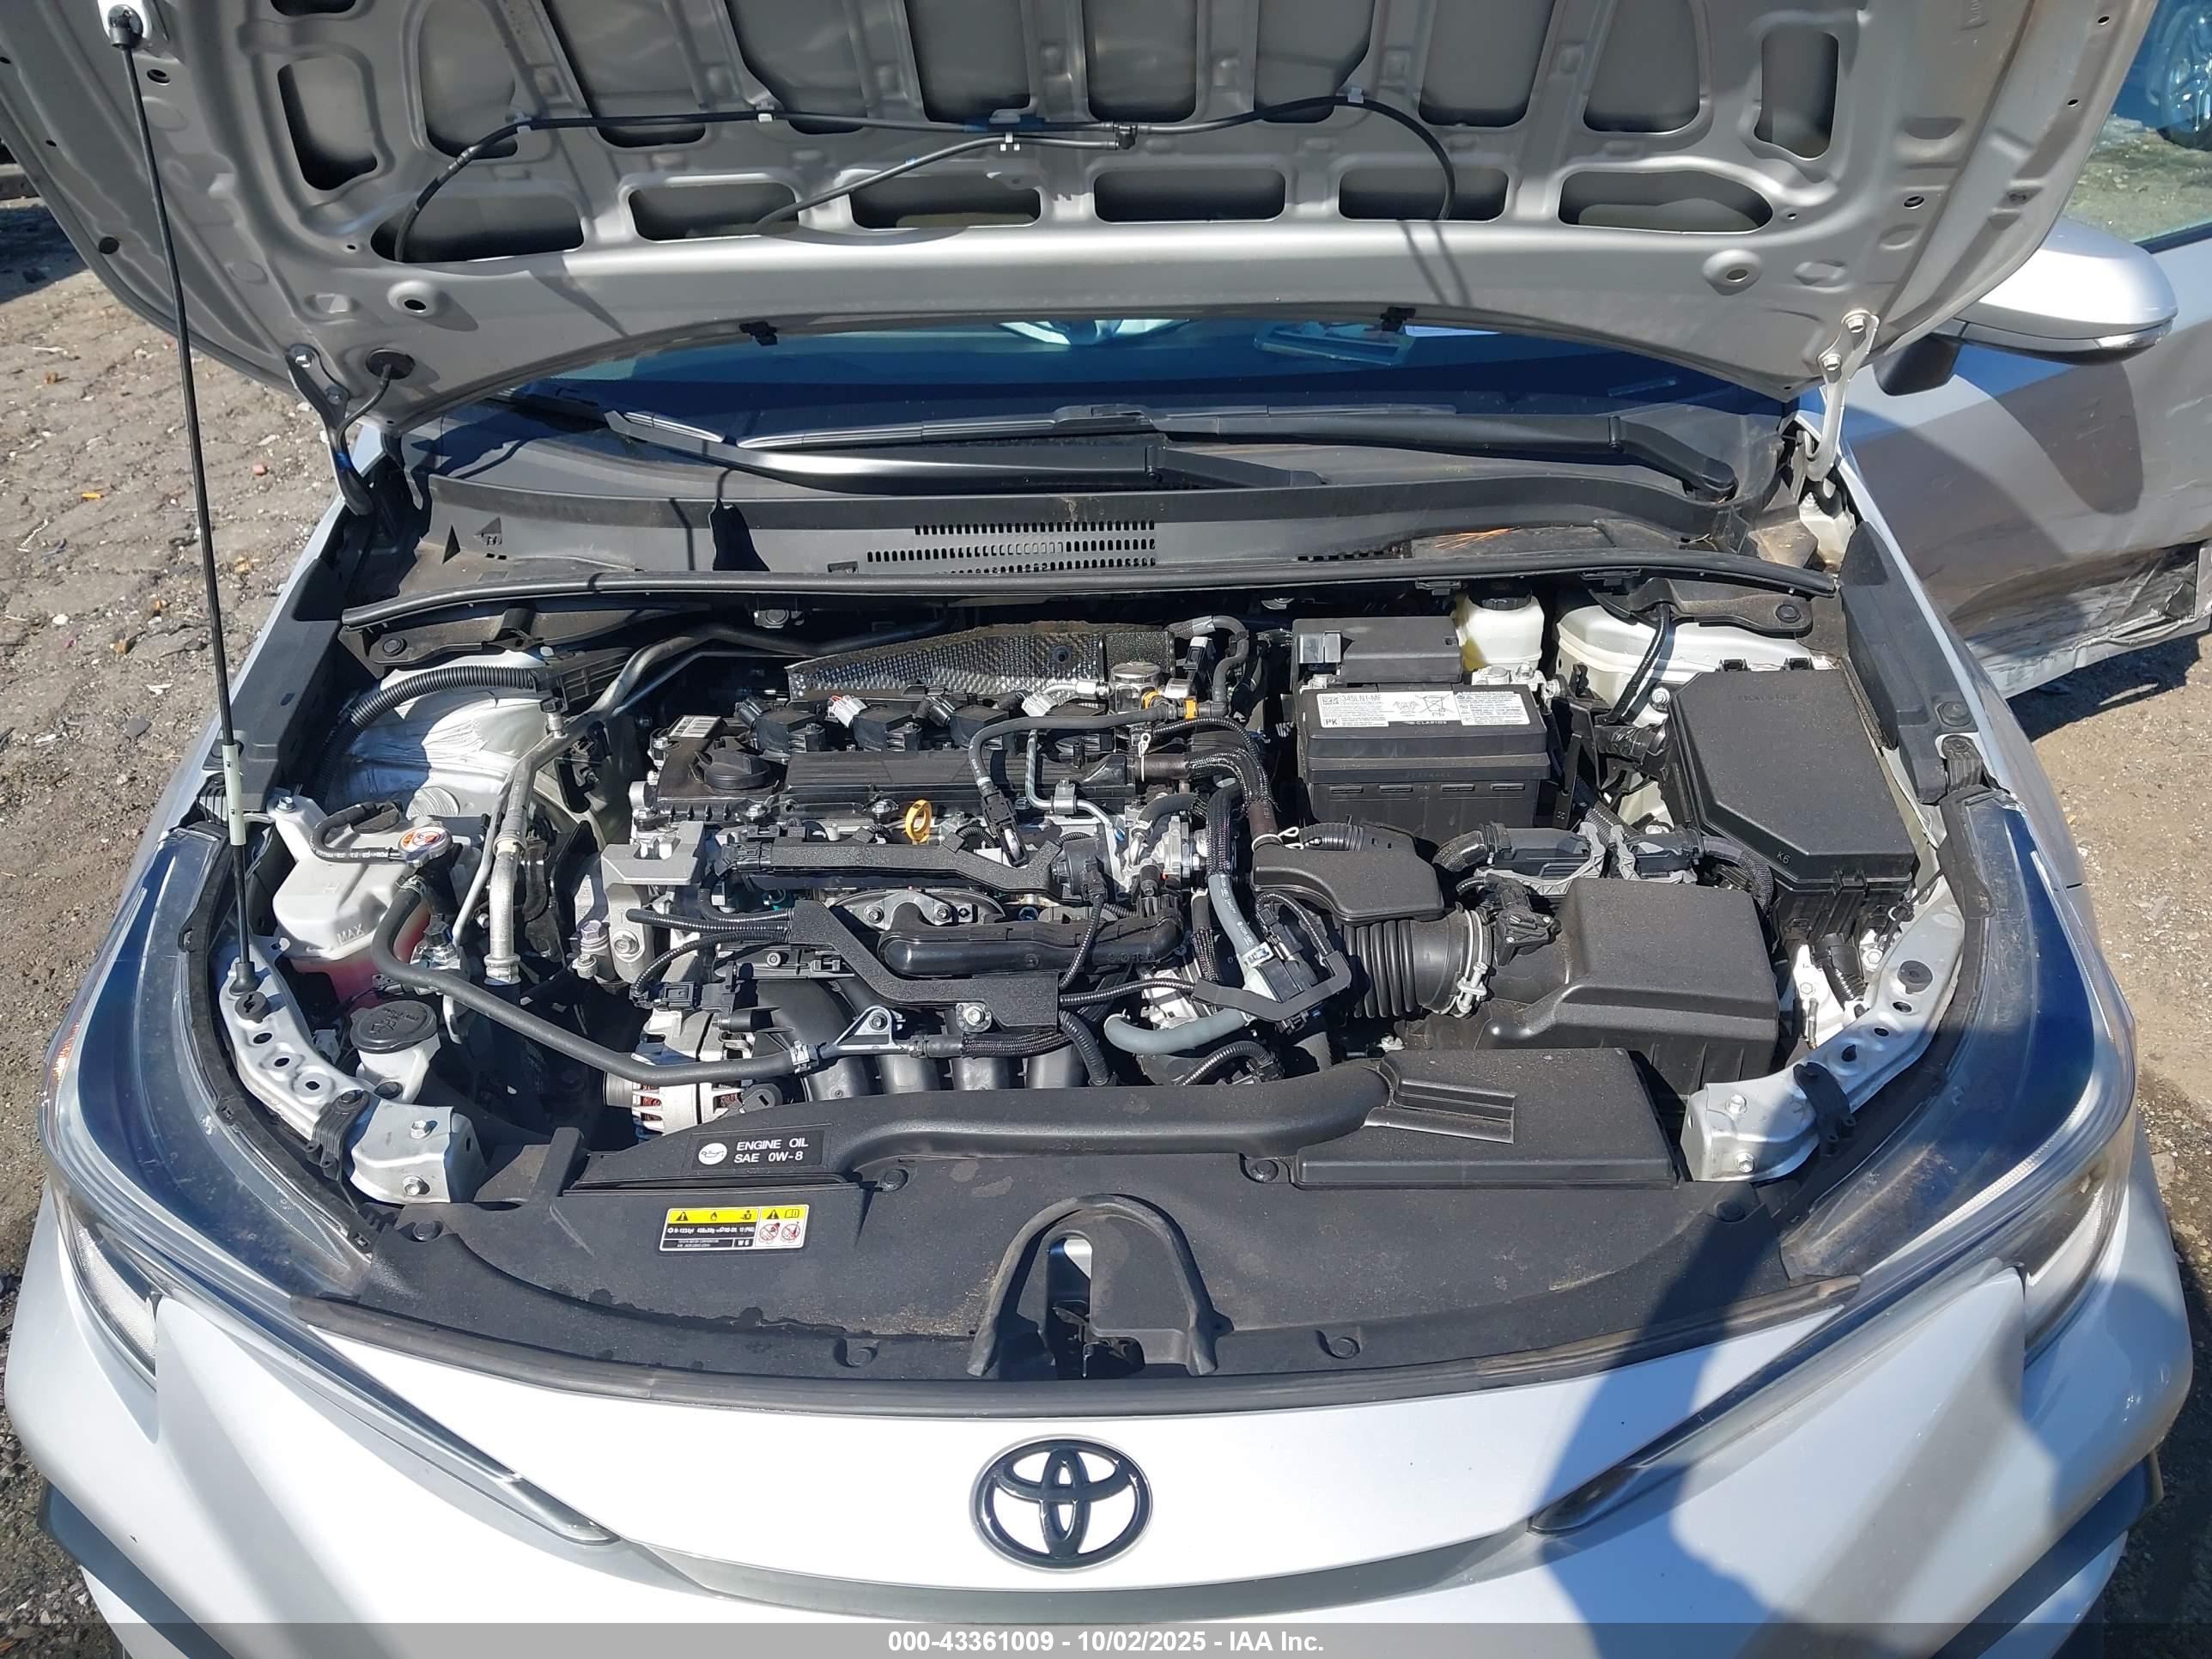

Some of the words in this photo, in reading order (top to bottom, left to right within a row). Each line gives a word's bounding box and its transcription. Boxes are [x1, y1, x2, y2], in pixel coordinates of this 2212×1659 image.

[1777, 851, 1790, 864] K6
[337, 923, 365, 945] MAX
[736, 1139, 782, 1152] ENGINE
[788, 1137, 809, 1148] OIL
[733, 1152, 761, 1164] SAE
[768, 1151, 804, 1162] 0W-8
